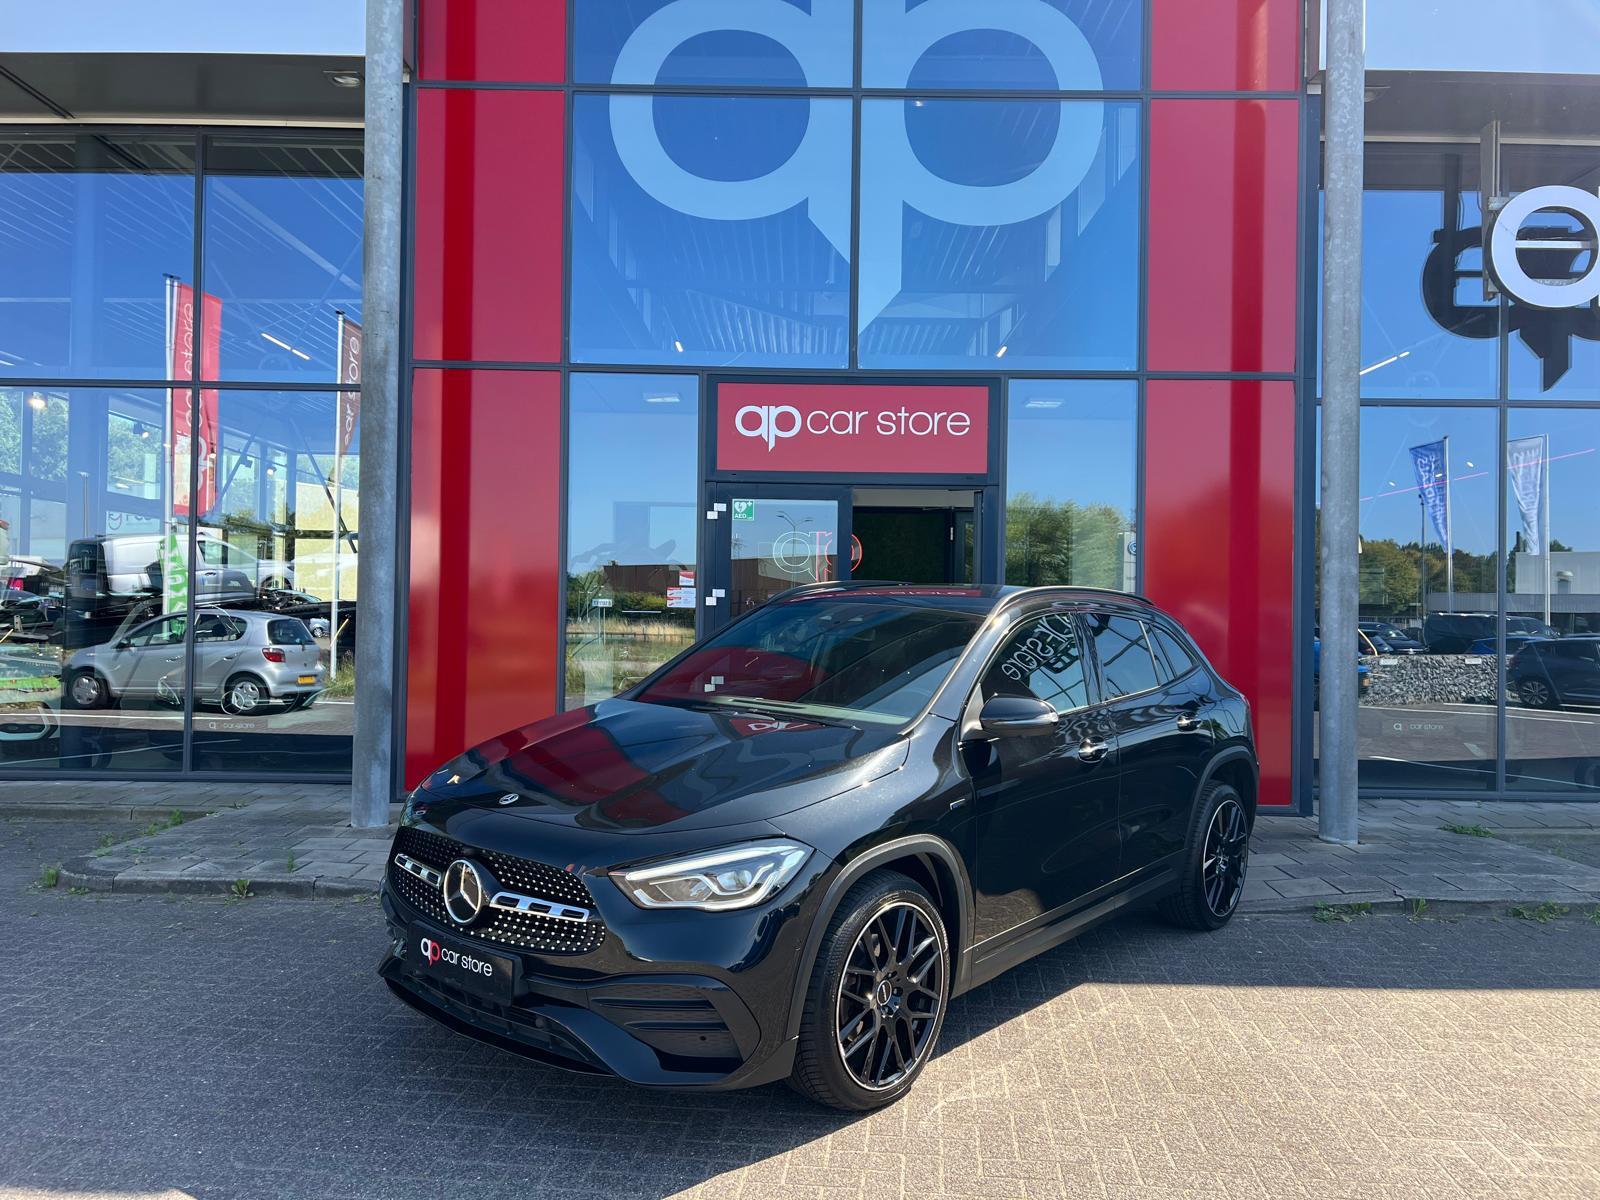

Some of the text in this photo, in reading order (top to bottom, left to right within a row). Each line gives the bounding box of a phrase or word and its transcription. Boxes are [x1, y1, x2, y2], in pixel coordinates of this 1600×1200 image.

[735, 405, 971, 452] ap car store
[420, 937, 493, 977] ap car store
